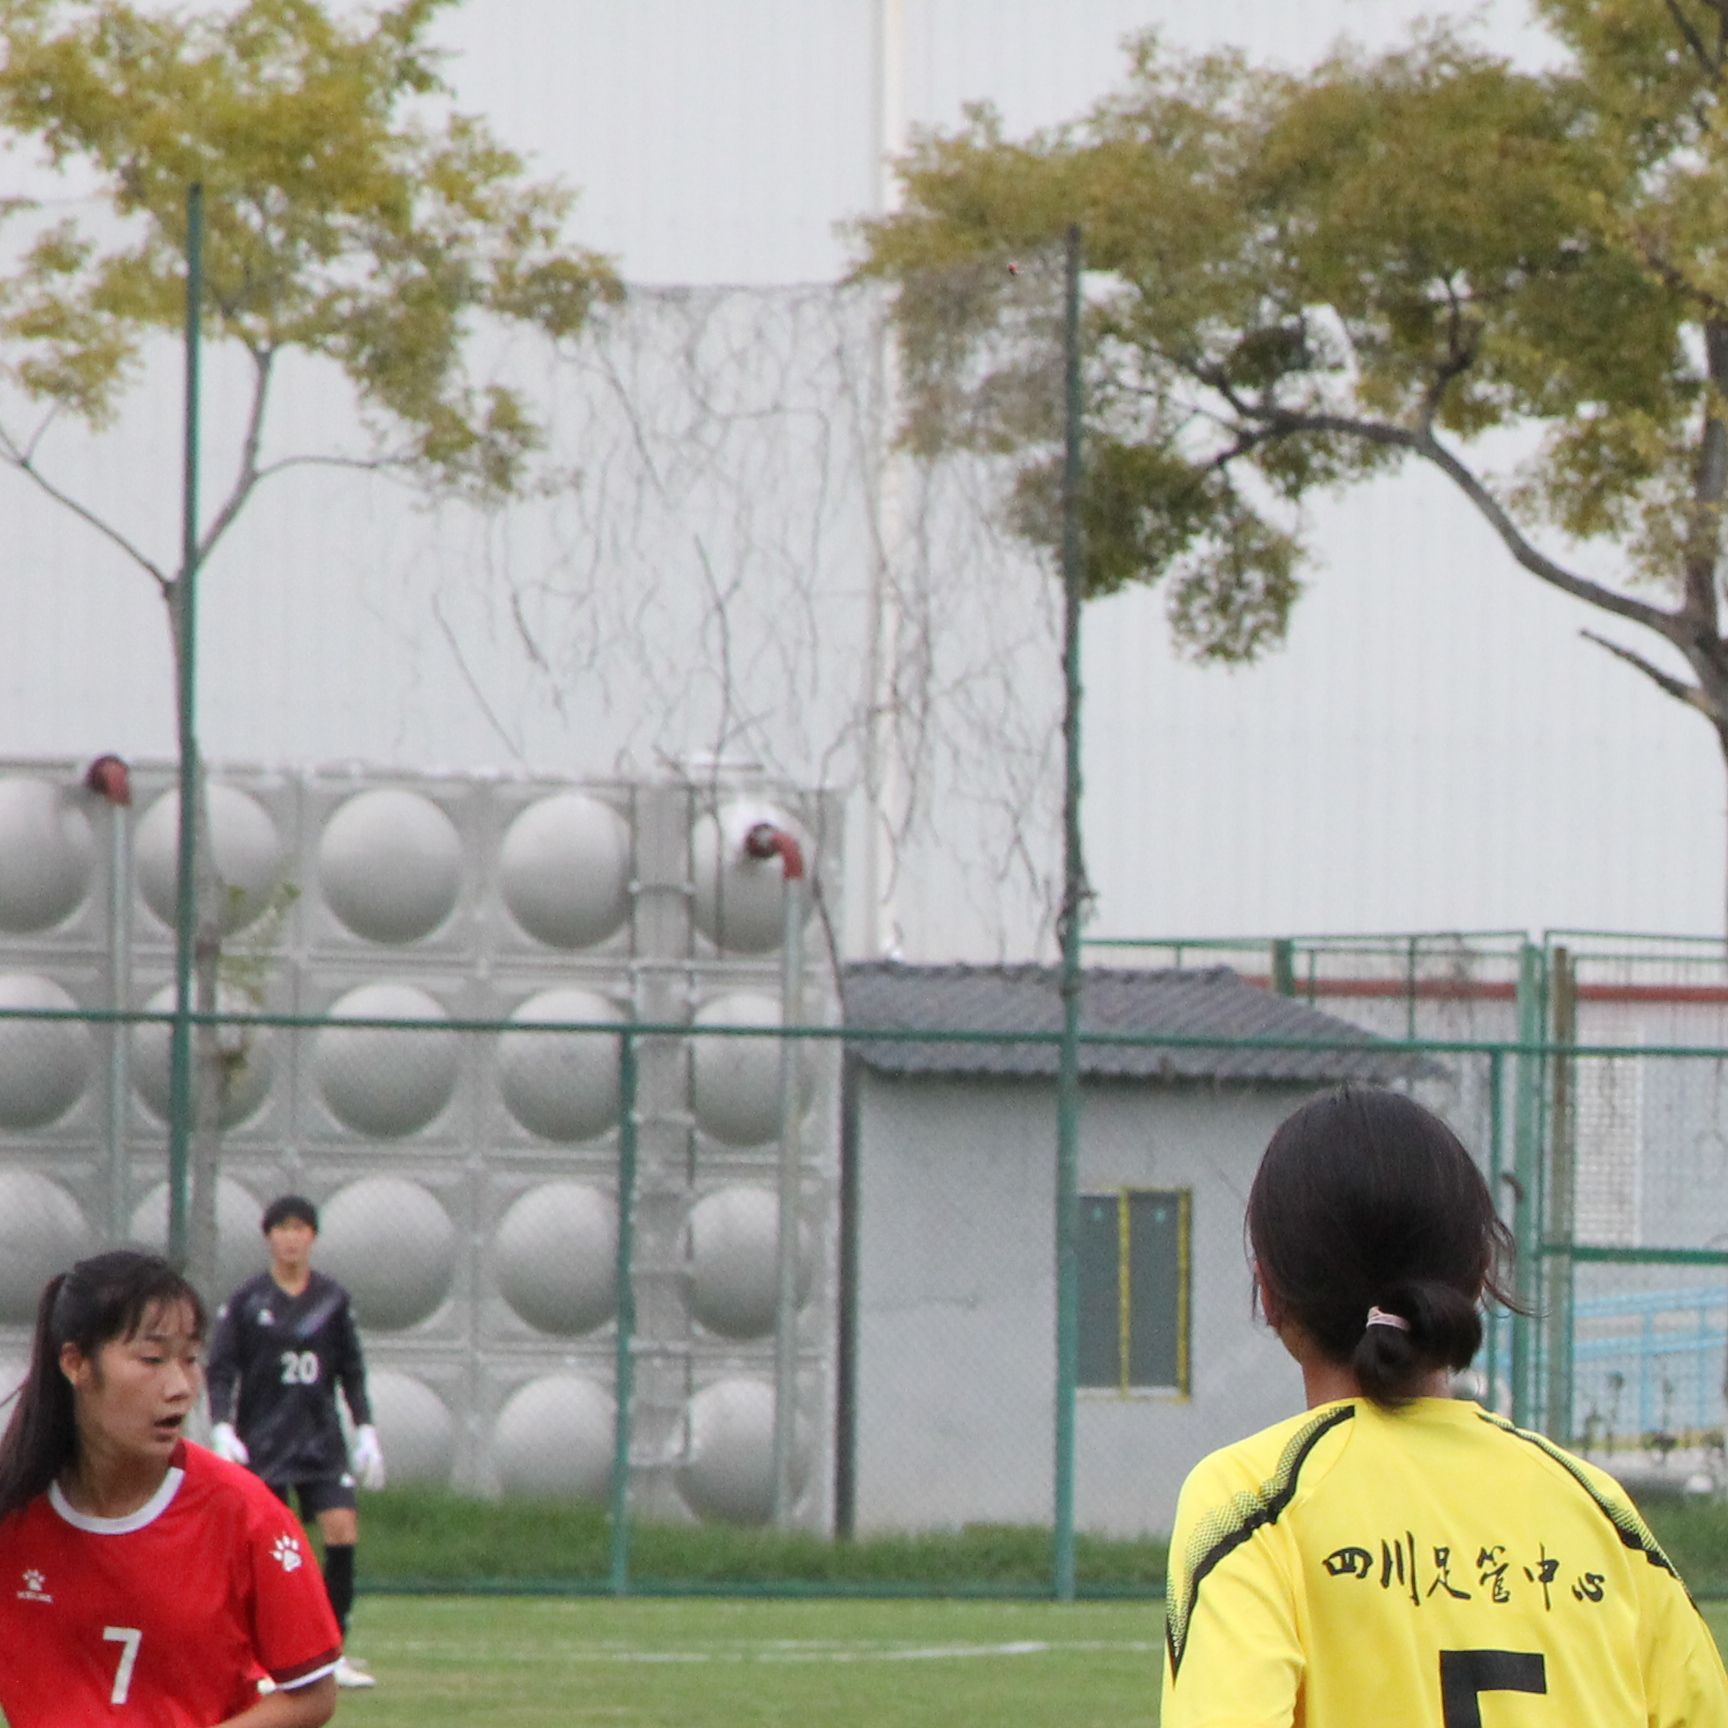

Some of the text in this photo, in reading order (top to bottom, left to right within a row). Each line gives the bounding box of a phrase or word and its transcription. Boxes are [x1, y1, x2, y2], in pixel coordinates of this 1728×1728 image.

[280, 1350, 319, 1385] 20
[1322, 1530, 1605, 1612] 四川足管中心
[102, 1625, 143, 1705] 7
